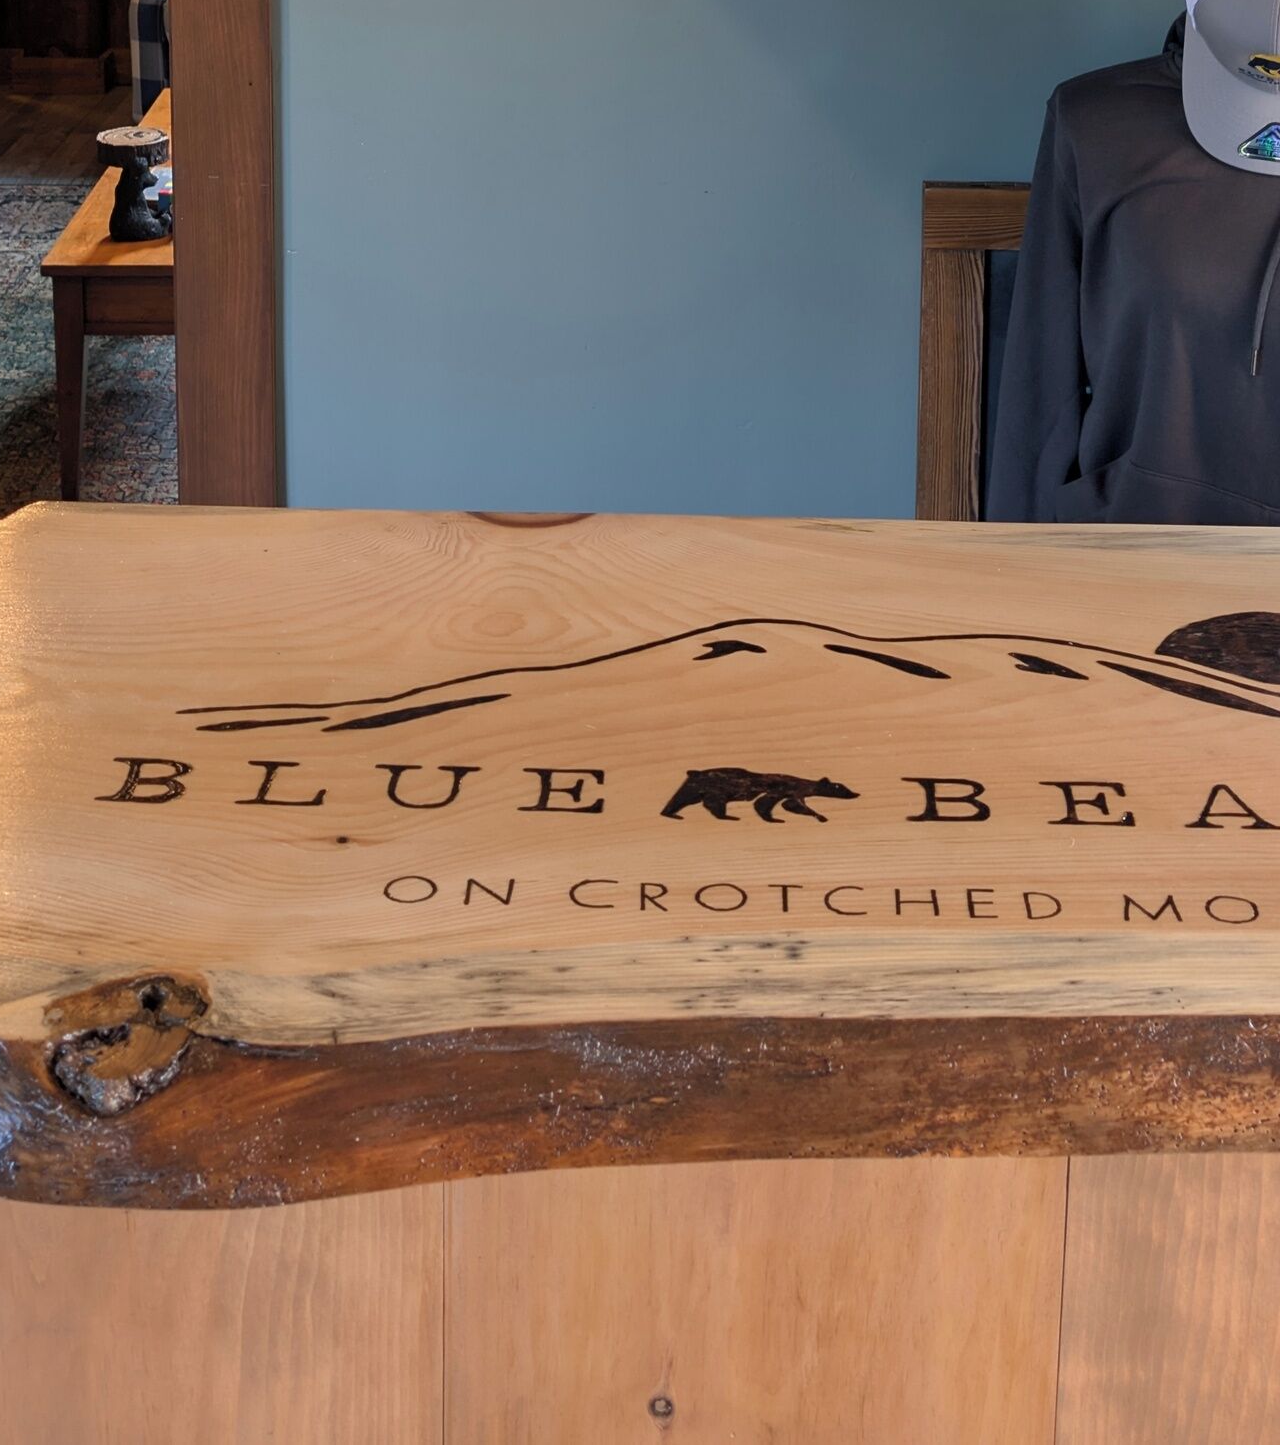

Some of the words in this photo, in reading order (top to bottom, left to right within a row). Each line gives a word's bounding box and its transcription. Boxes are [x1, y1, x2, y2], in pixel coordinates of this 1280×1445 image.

[94, 756, 607, 814] BLUE
[382, 875, 516, 906] ON
[569, 879, 1062, 921] CROTCHED
